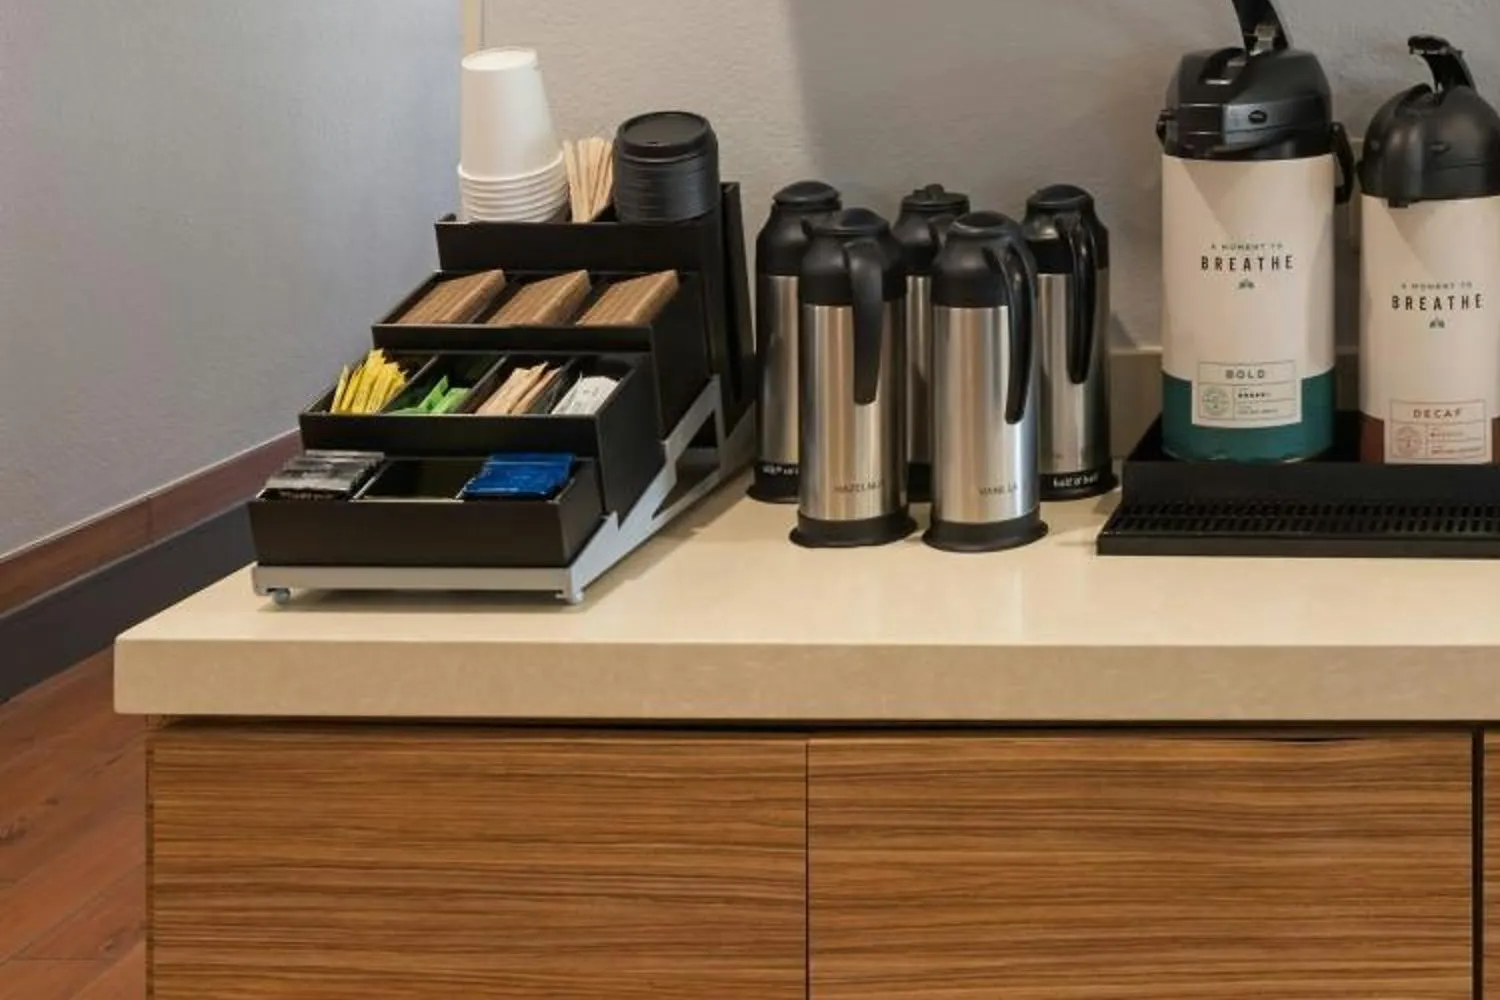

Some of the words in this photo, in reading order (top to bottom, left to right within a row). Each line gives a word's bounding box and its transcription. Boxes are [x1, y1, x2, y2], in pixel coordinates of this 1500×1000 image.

[1200, 255, 1294, 272] BREATHE
[1391, 293, 1484, 311] BREATHE
[1225, 369, 1266, 379] BOLD
[1413, 408, 1462, 419] DECAF
